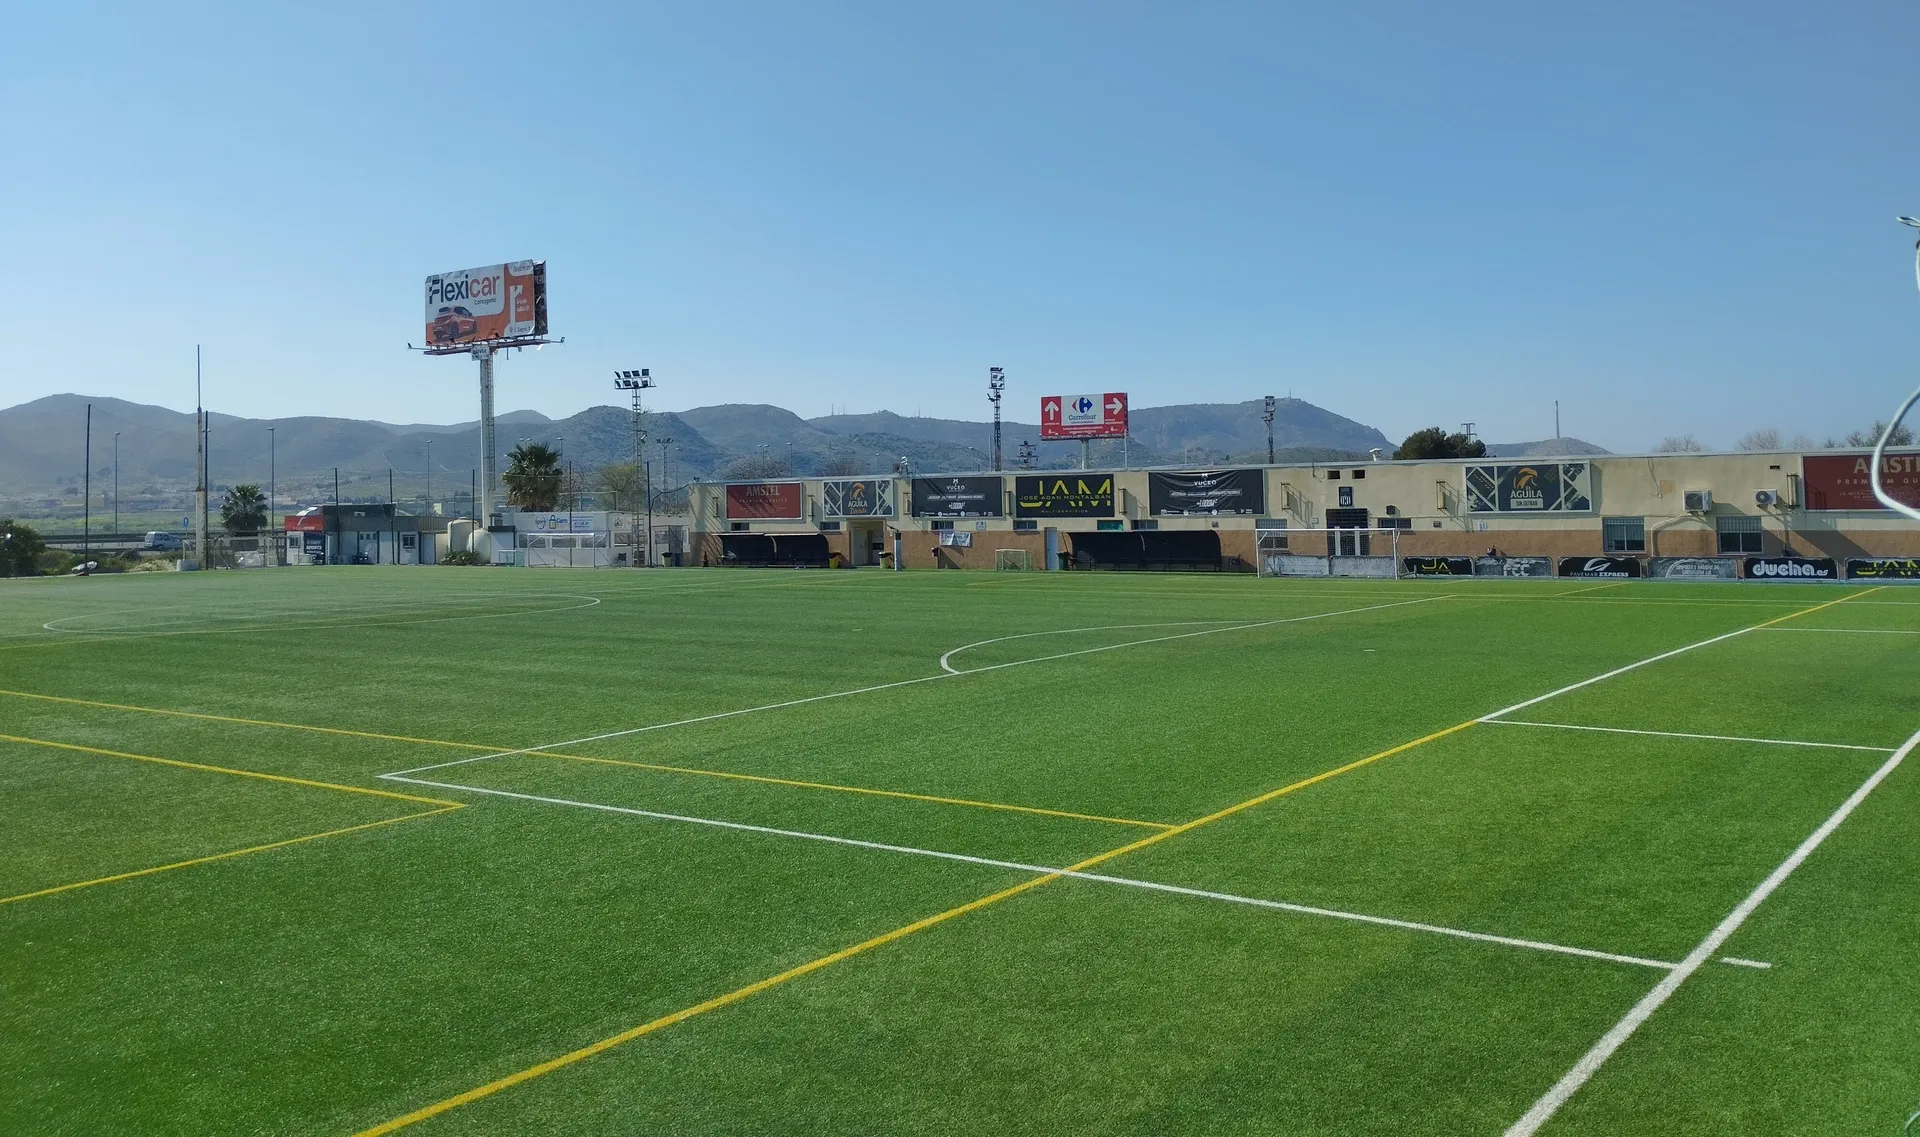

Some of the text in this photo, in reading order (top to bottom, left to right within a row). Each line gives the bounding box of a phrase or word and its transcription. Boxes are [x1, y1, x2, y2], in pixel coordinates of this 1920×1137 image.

[428, 274, 500, 304] Flexicar
[746, 484, 781, 496] AMSTEL
[1020, 479, 1111, 507] JAM
[1752, 561, 1828, 576] ducha.es
